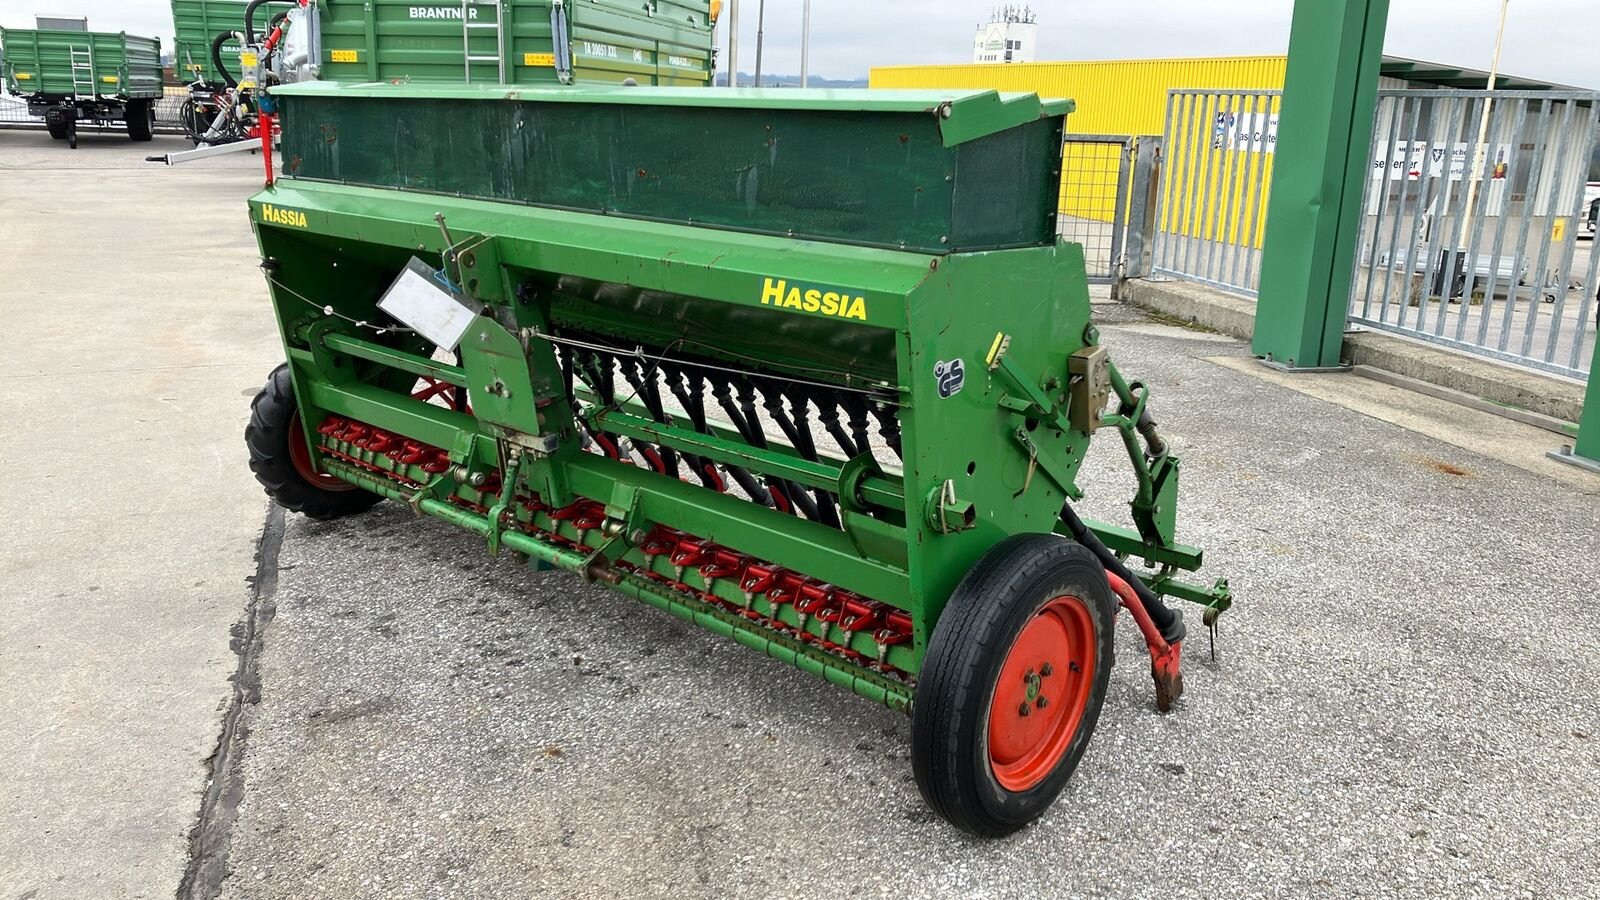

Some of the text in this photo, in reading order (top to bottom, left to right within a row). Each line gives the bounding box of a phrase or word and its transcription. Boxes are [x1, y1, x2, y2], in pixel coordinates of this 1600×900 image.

[409, 7, 478, 19] BRANTNR
[583, 41, 592, 55] TA
[262, 203, 308, 228] HASSIA
[761, 278, 867, 321] HASSIA
